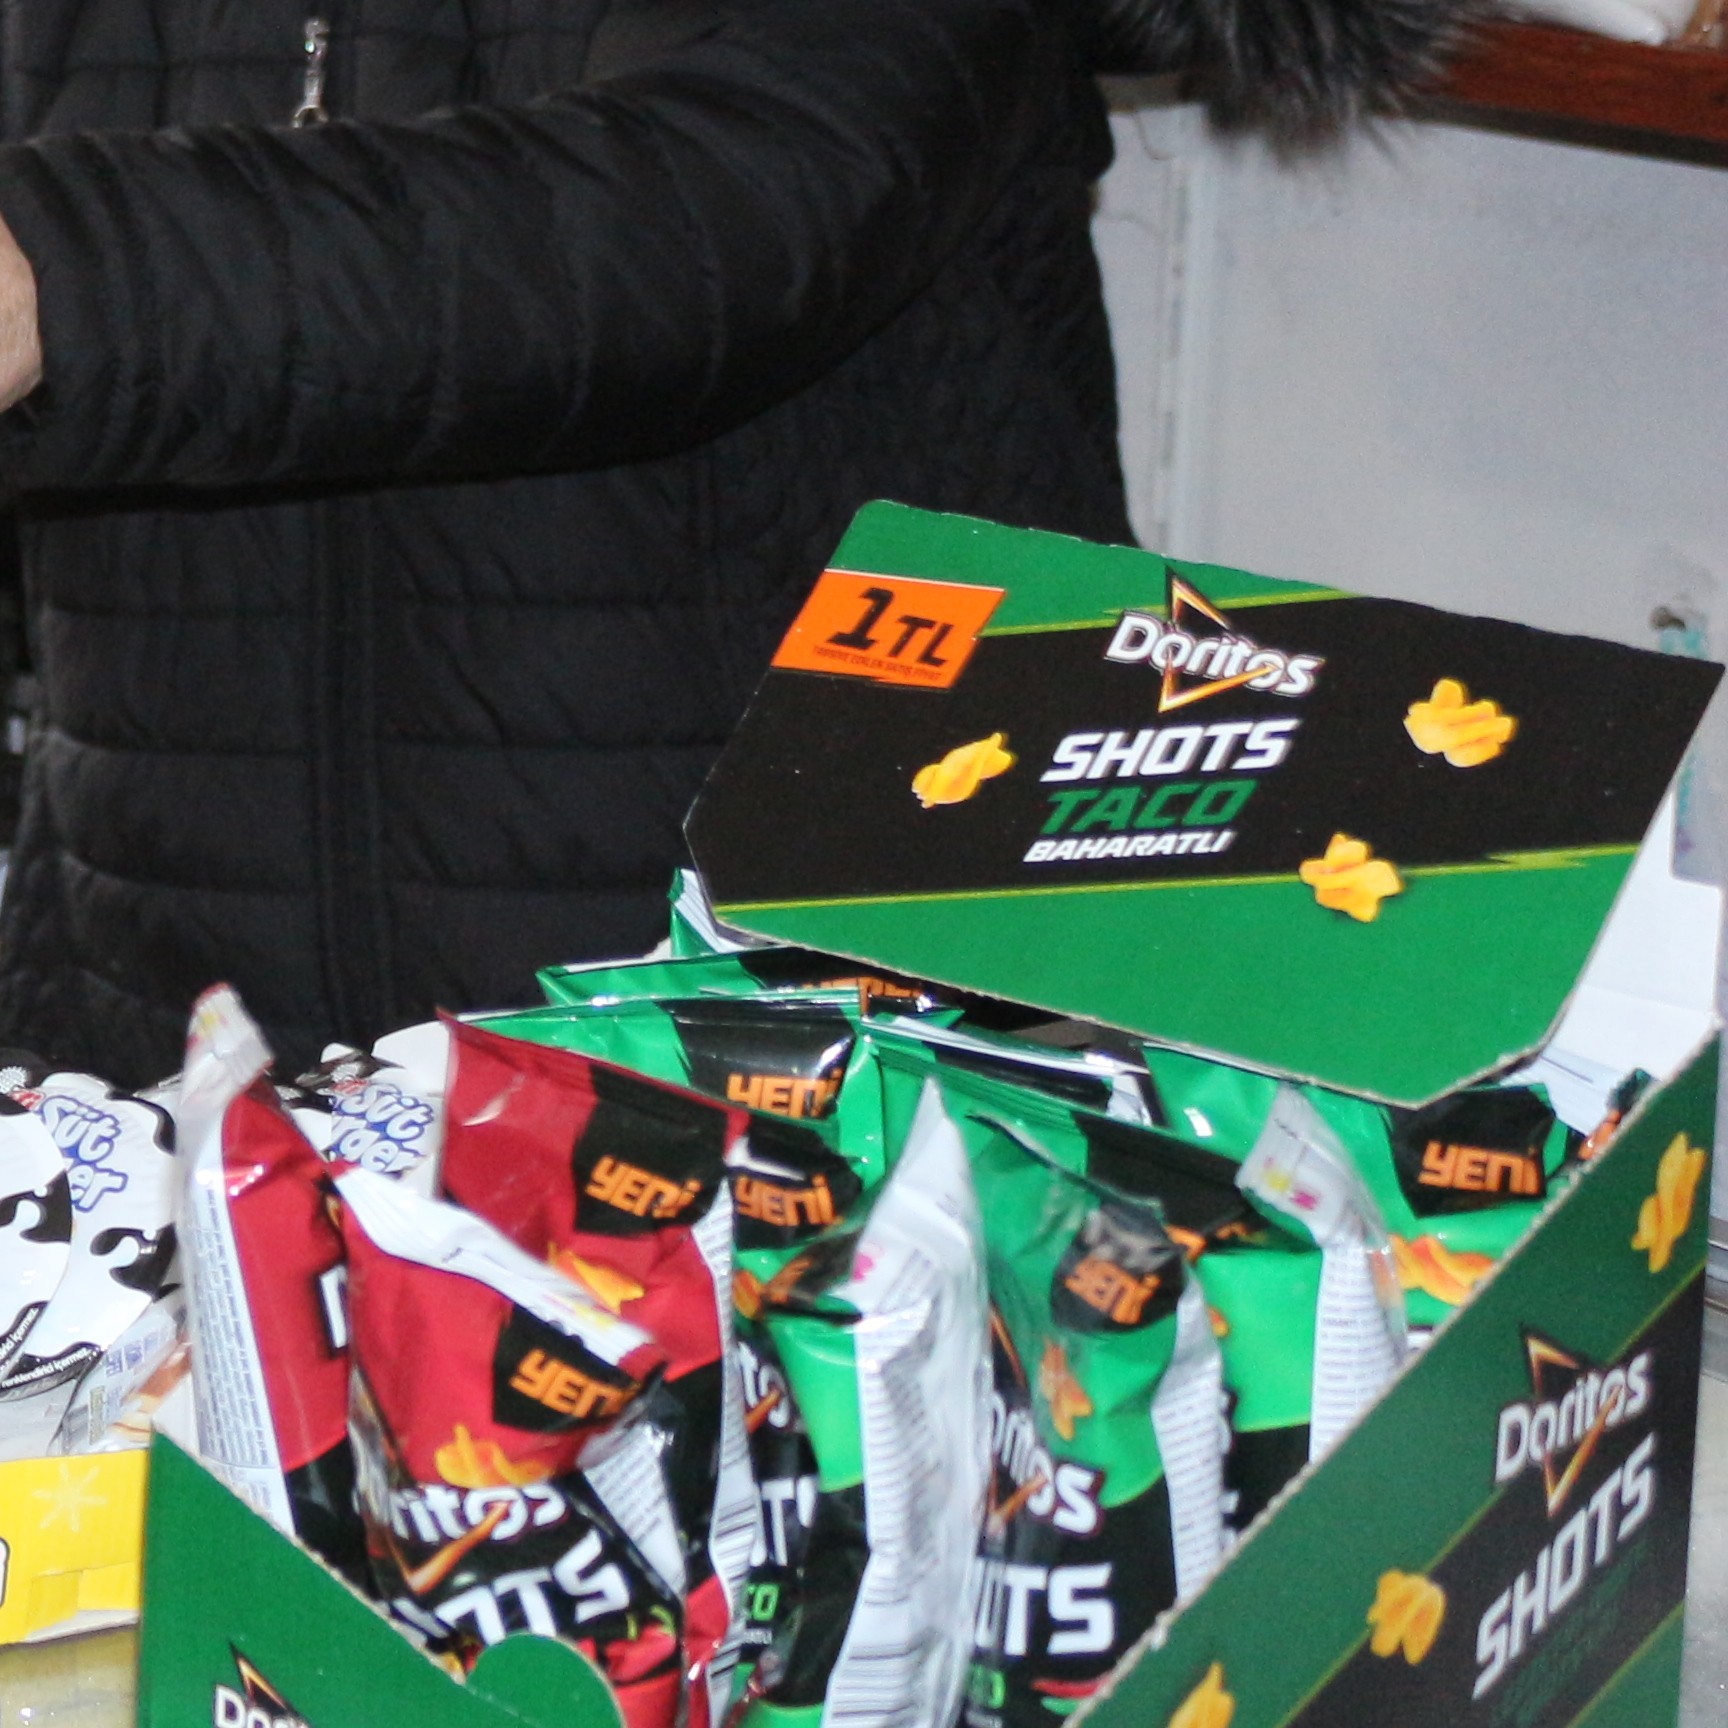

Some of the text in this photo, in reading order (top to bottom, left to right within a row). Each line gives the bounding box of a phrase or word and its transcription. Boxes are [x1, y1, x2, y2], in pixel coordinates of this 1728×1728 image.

[826, 586, 955, 668] 1 TL
[1104, 609, 1325, 698] Doritos
[1040, 718, 1301, 783] SHOTS
[1024, 830, 1235, 864] BAHARATLI
[1042, 779, 1259, 836] TACO
[1495, 1351, 1650, 1484] Doritos
[1472, 1433, 1657, 1701] SHOTS
